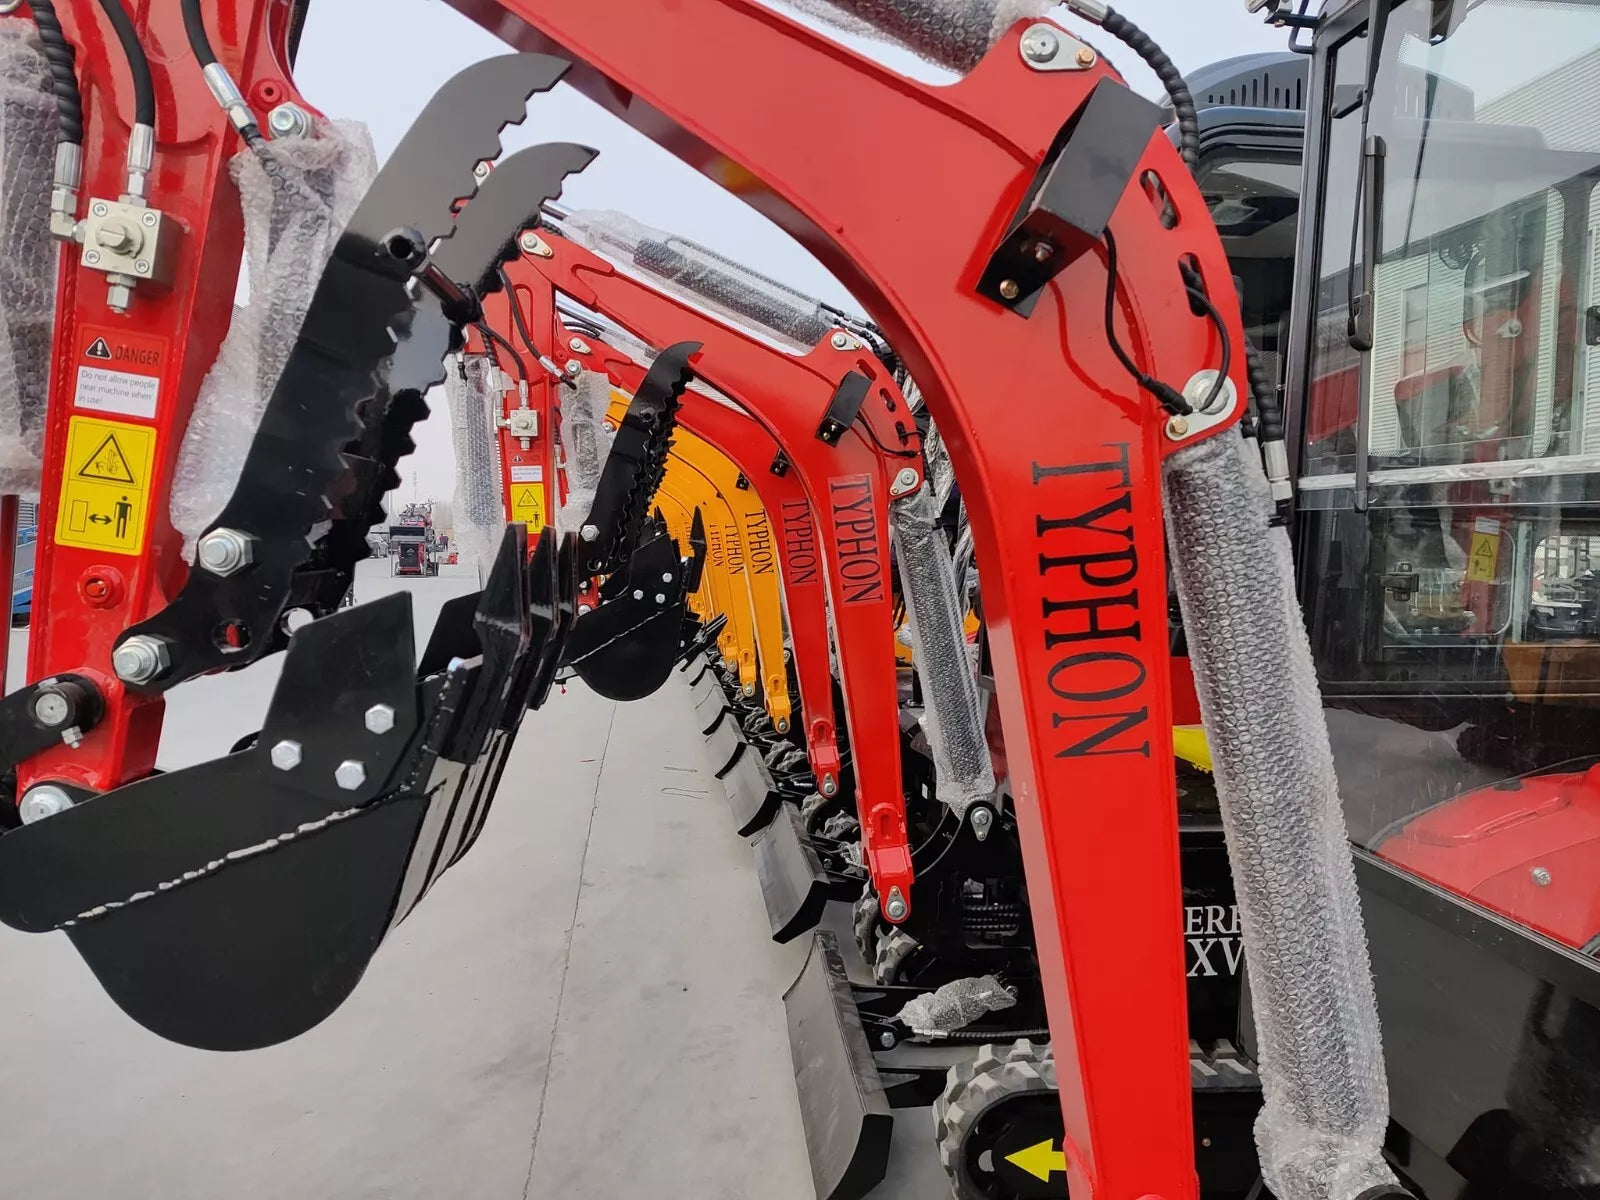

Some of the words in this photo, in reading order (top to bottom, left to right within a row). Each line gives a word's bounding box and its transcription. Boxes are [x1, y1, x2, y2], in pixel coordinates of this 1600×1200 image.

[82, 370, 92, 379] Do
[94, 373, 107, 382] not
[109, 375, 128, 384] allow
[130, 379, 156, 390] people
[115, 345, 160, 366] DANGER
[79, 383, 96, 391] near
[98, 386, 130, 396] machine
[131, 391, 151, 400] when
[745, 508, 774, 575] TYPHON
[782, 497, 818, 585] TYPHON
[830, 474, 884, 603] TYPHON
[1032, 441, 1150, 758] TYPHON
